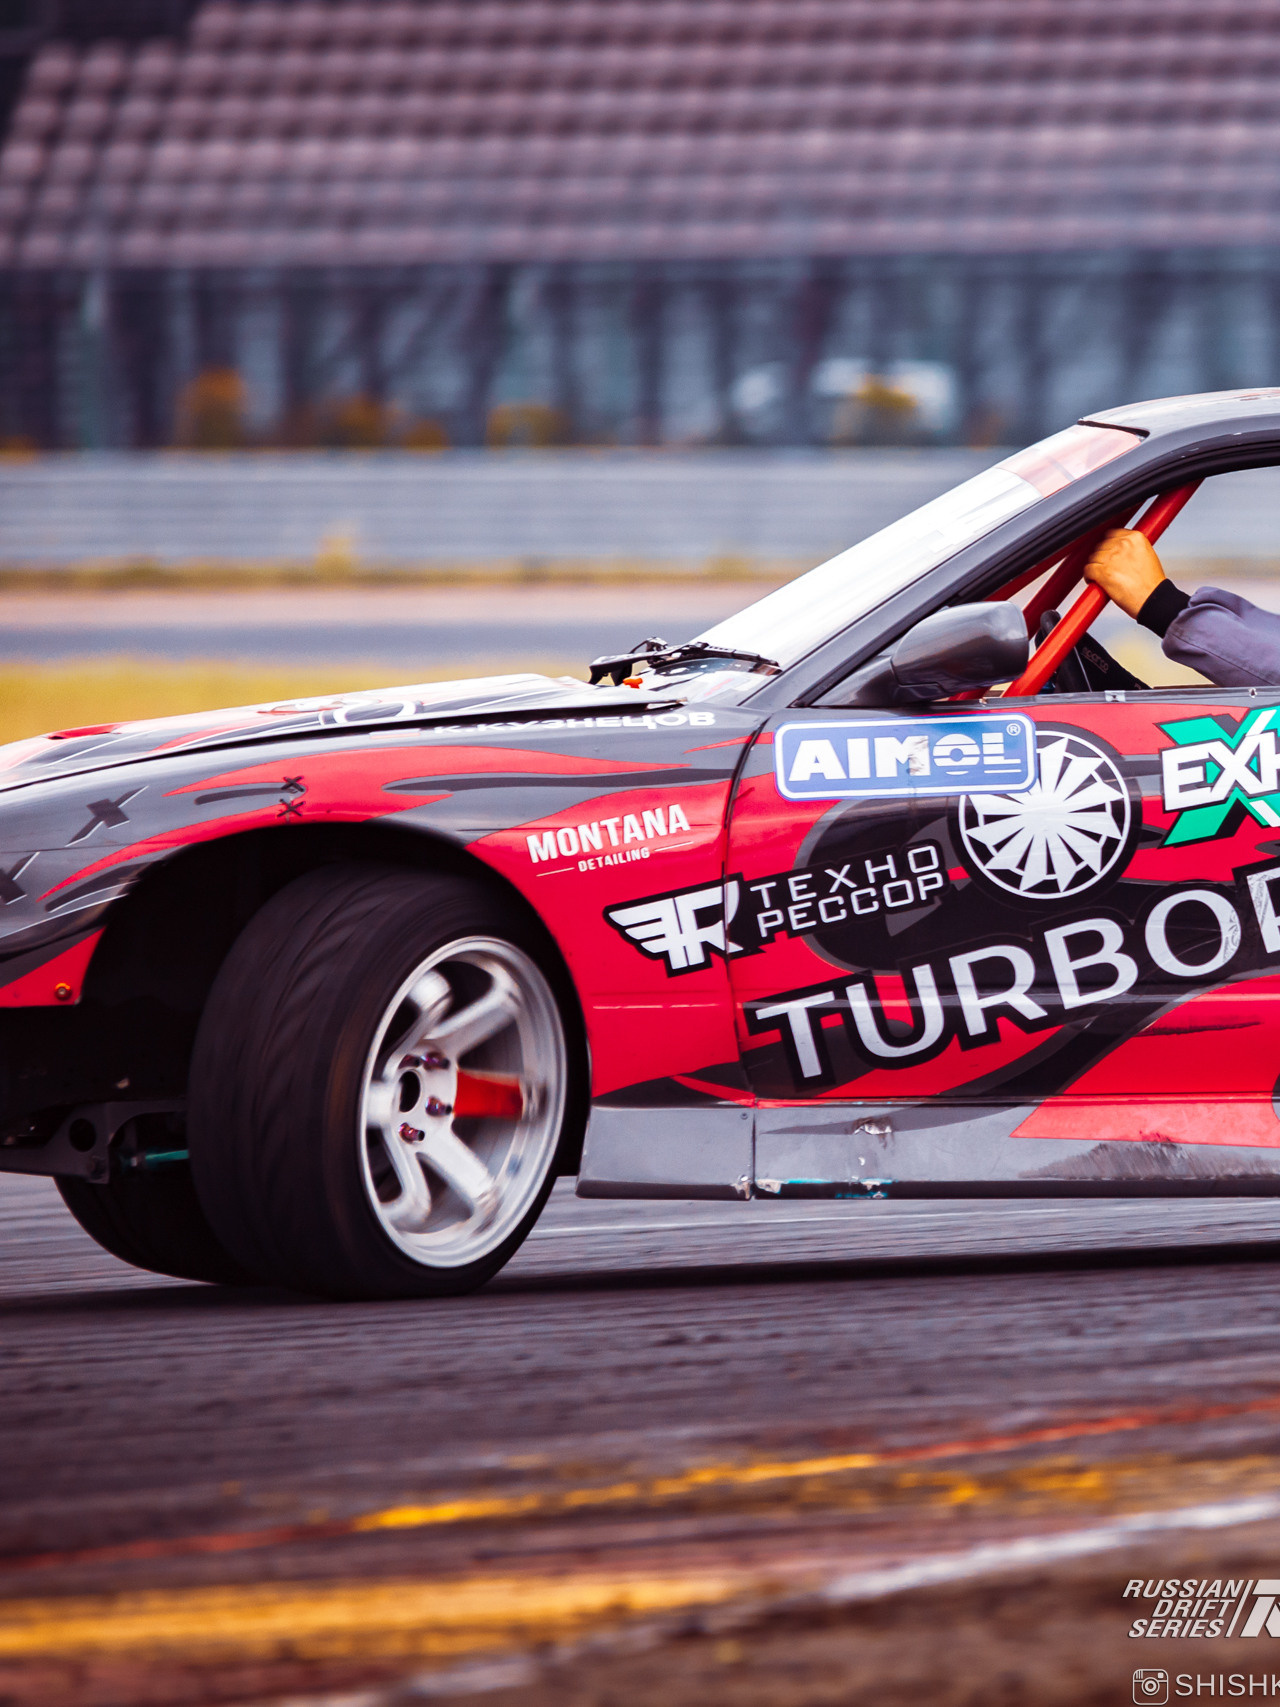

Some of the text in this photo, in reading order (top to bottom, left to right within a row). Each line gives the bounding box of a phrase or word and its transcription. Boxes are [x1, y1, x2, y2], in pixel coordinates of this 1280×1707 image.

[787, 732, 1022, 782] AIMOL
[526, 804, 691, 864] MONTANA
[578, 847, 651, 873] DETAILING
[750, 845, 939, 909] ТЕХНО
[756, 872, 945, 938] РЕССОР
